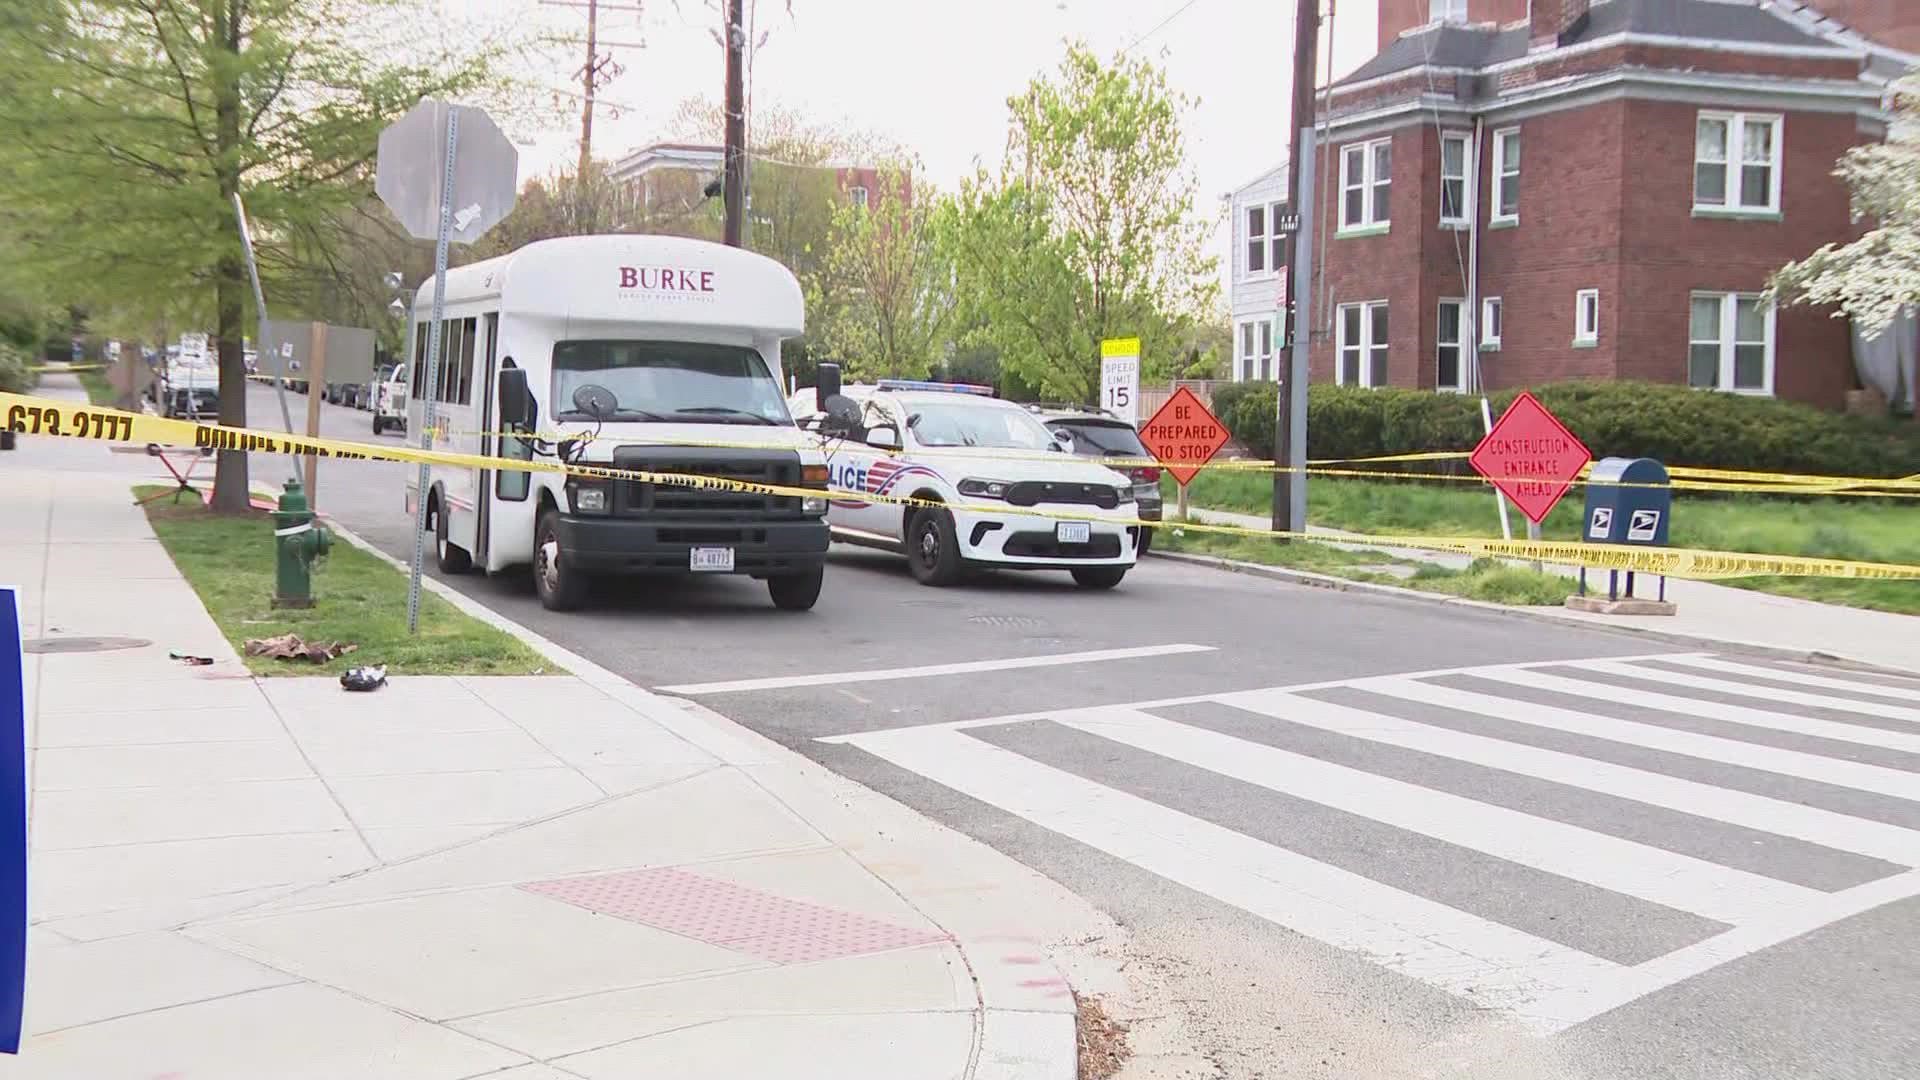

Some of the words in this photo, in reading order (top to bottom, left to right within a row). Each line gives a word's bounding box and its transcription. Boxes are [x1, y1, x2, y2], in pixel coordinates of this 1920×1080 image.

[619, 266, 715, 292] BURKE
[1105, 343, 1136, 354] SCHOOL
[1105, 362, 1135, 373] SPEED
[1107, 374, 1130, 385] LIMIT
[1109, 386, 1129, 408] 15
[1175, 406, 1191, 420] BE
[1150, 425, 1217, 440] PREPARED
[1158, 445, 1173, 459] TO
[1179, 445, 1211, 459] STOP
[1490, 438, 1570, 456] CONSTRUCTION
[1504, 460, 1559, 476] ENTRANCE
[829, 463, 866, 492] LICE
[1516, 481, 1552, 496] AHEAD
